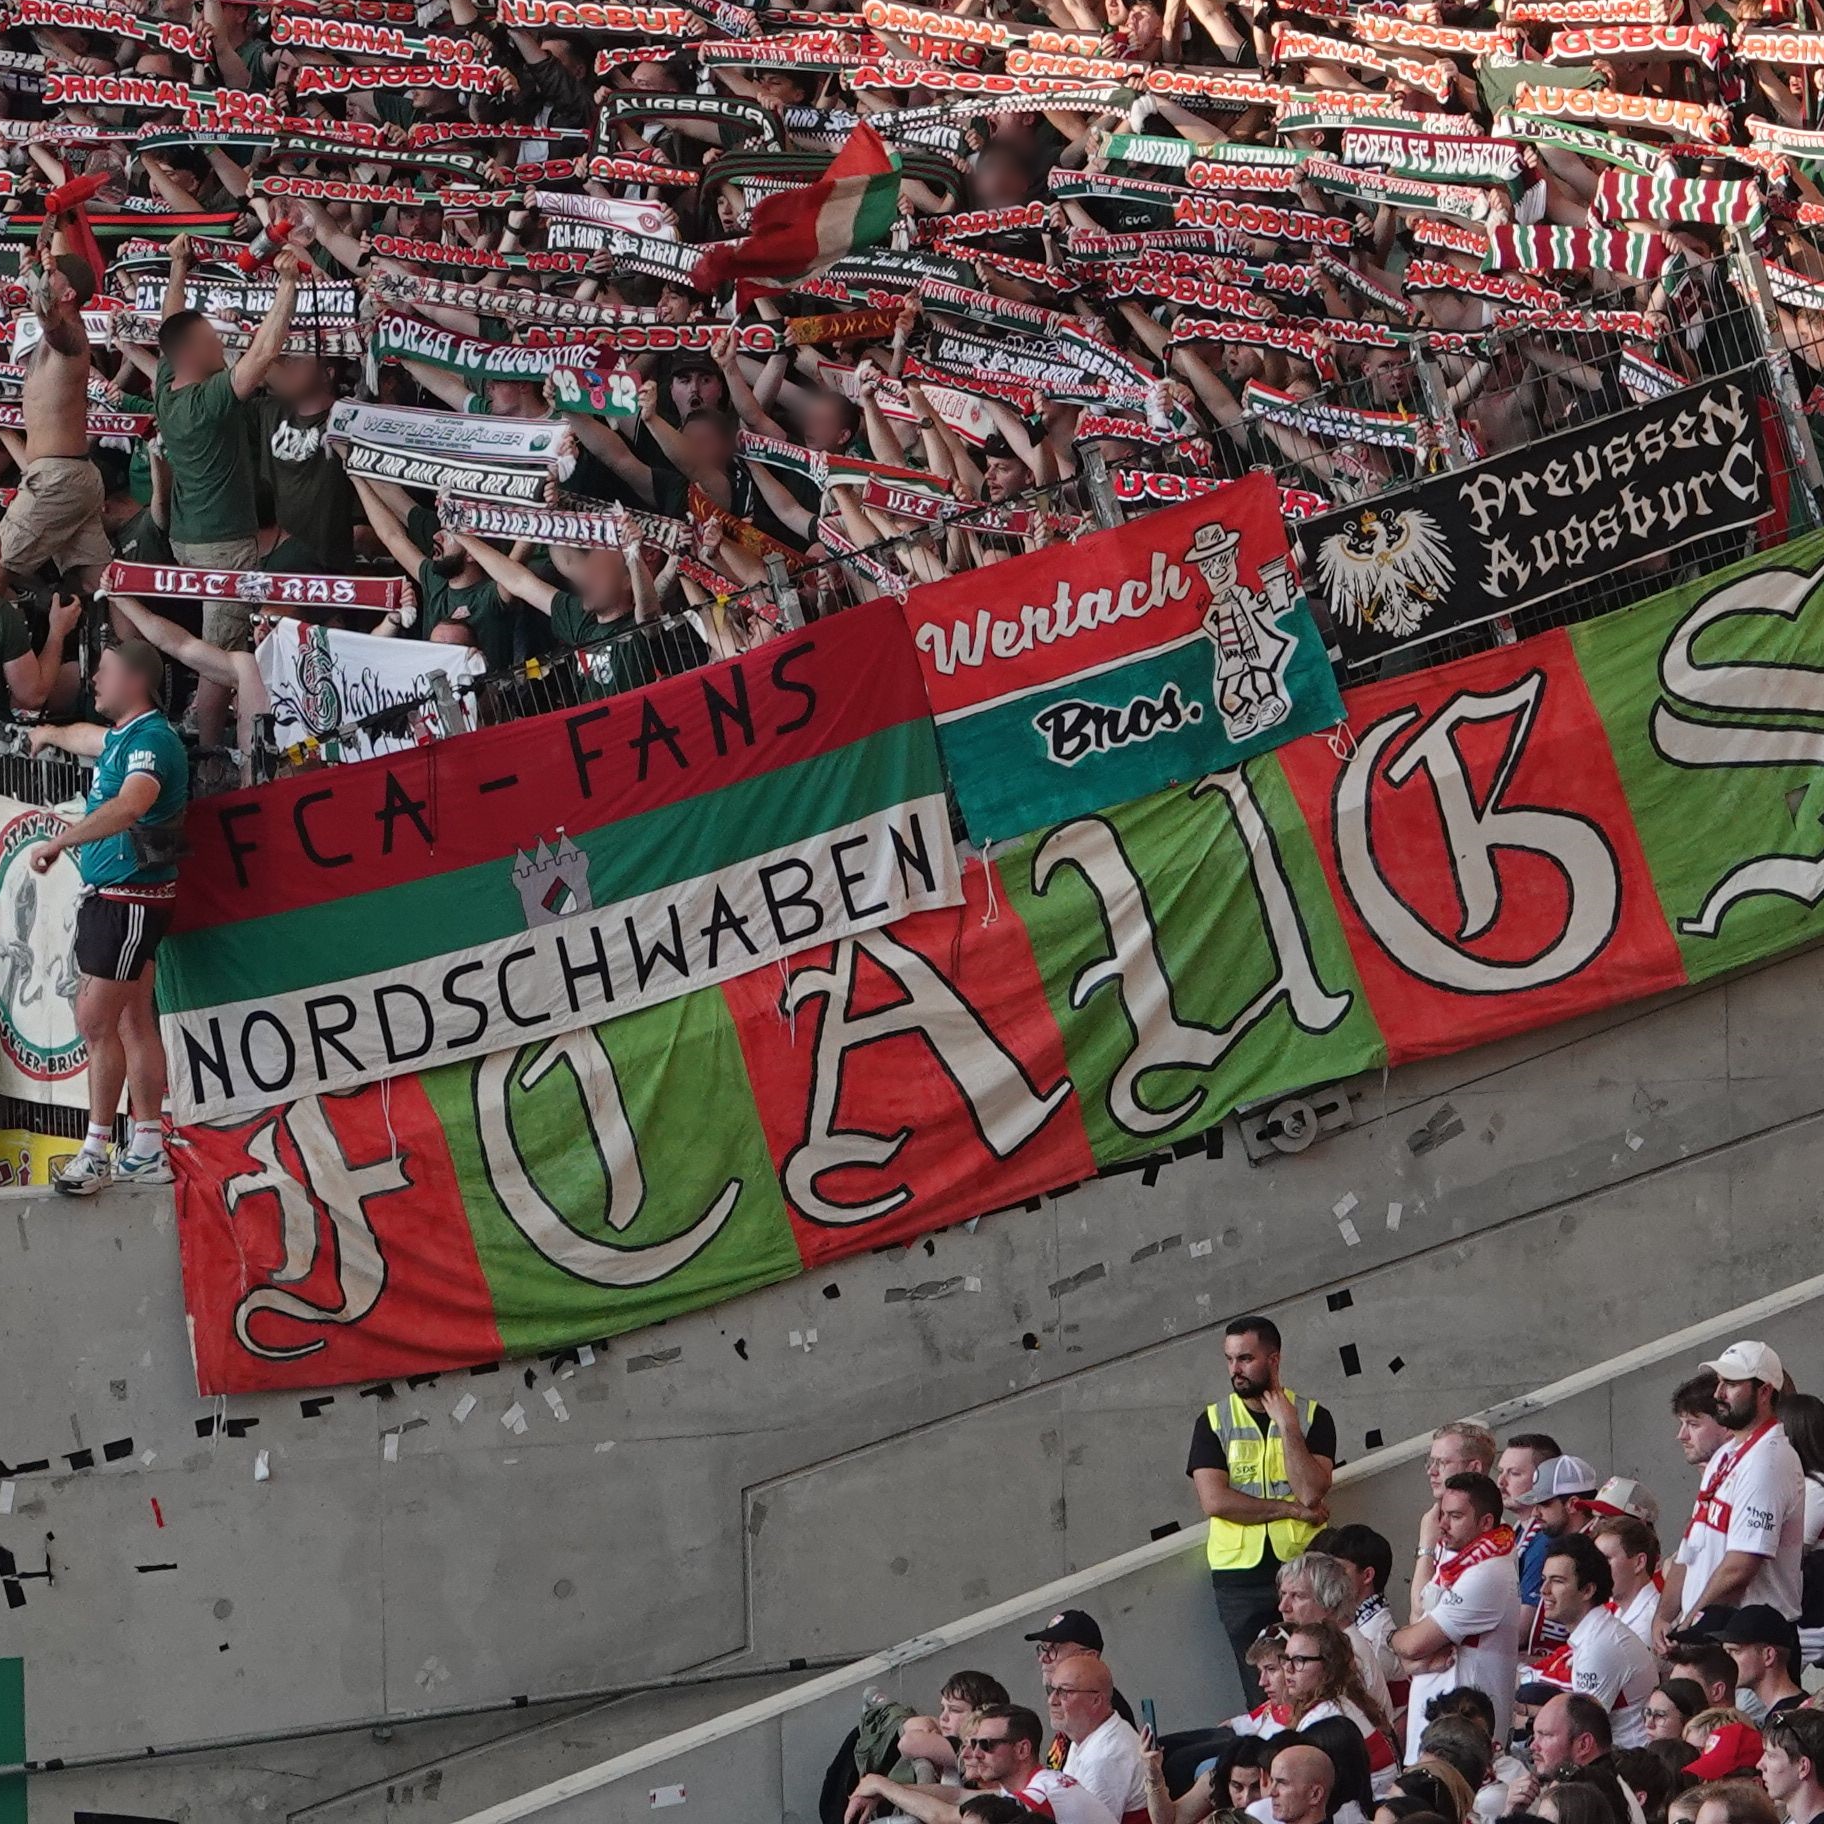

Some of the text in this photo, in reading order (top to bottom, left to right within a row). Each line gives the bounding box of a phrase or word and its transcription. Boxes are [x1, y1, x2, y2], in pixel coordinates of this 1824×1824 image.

[272, 15, 408, 56] ORIGINAL
[1147, 71, 1294, 103] ORIGINAL
[286, 137, 474, 169] AUGSBURG
[1128, 137, 1192, 167] AUSTRIA
[1343, 132, 1523, 178] FORZA FC AUGSBURG
[260, 177, 419, 205] ORIGINAL
[546, 221, 605, 251] FCA-FANS
[1178, 197, 1354, 246] AUGSBURG
[373, 235, 589, 272] ORIGINAL 1907
[379, 315, 601, 375] FORZA FC AUGSBURG
[523, 323, 777, 353] AUGSBURG
[554, 372, 638, 410] 13 12
[363, 415, 538, 448] WESTLICHE WÄLDER
[154, 569, 356, 603] ULT RAS
[916, 549, 1195, 677] Wertach
[1033, 684, 1205, 770] Bros.
[221, 775, 436, 889] FCA
[566, 640, 819, 803] FANS
[183, 823, 937, 1105] NORDSCHWABEN
